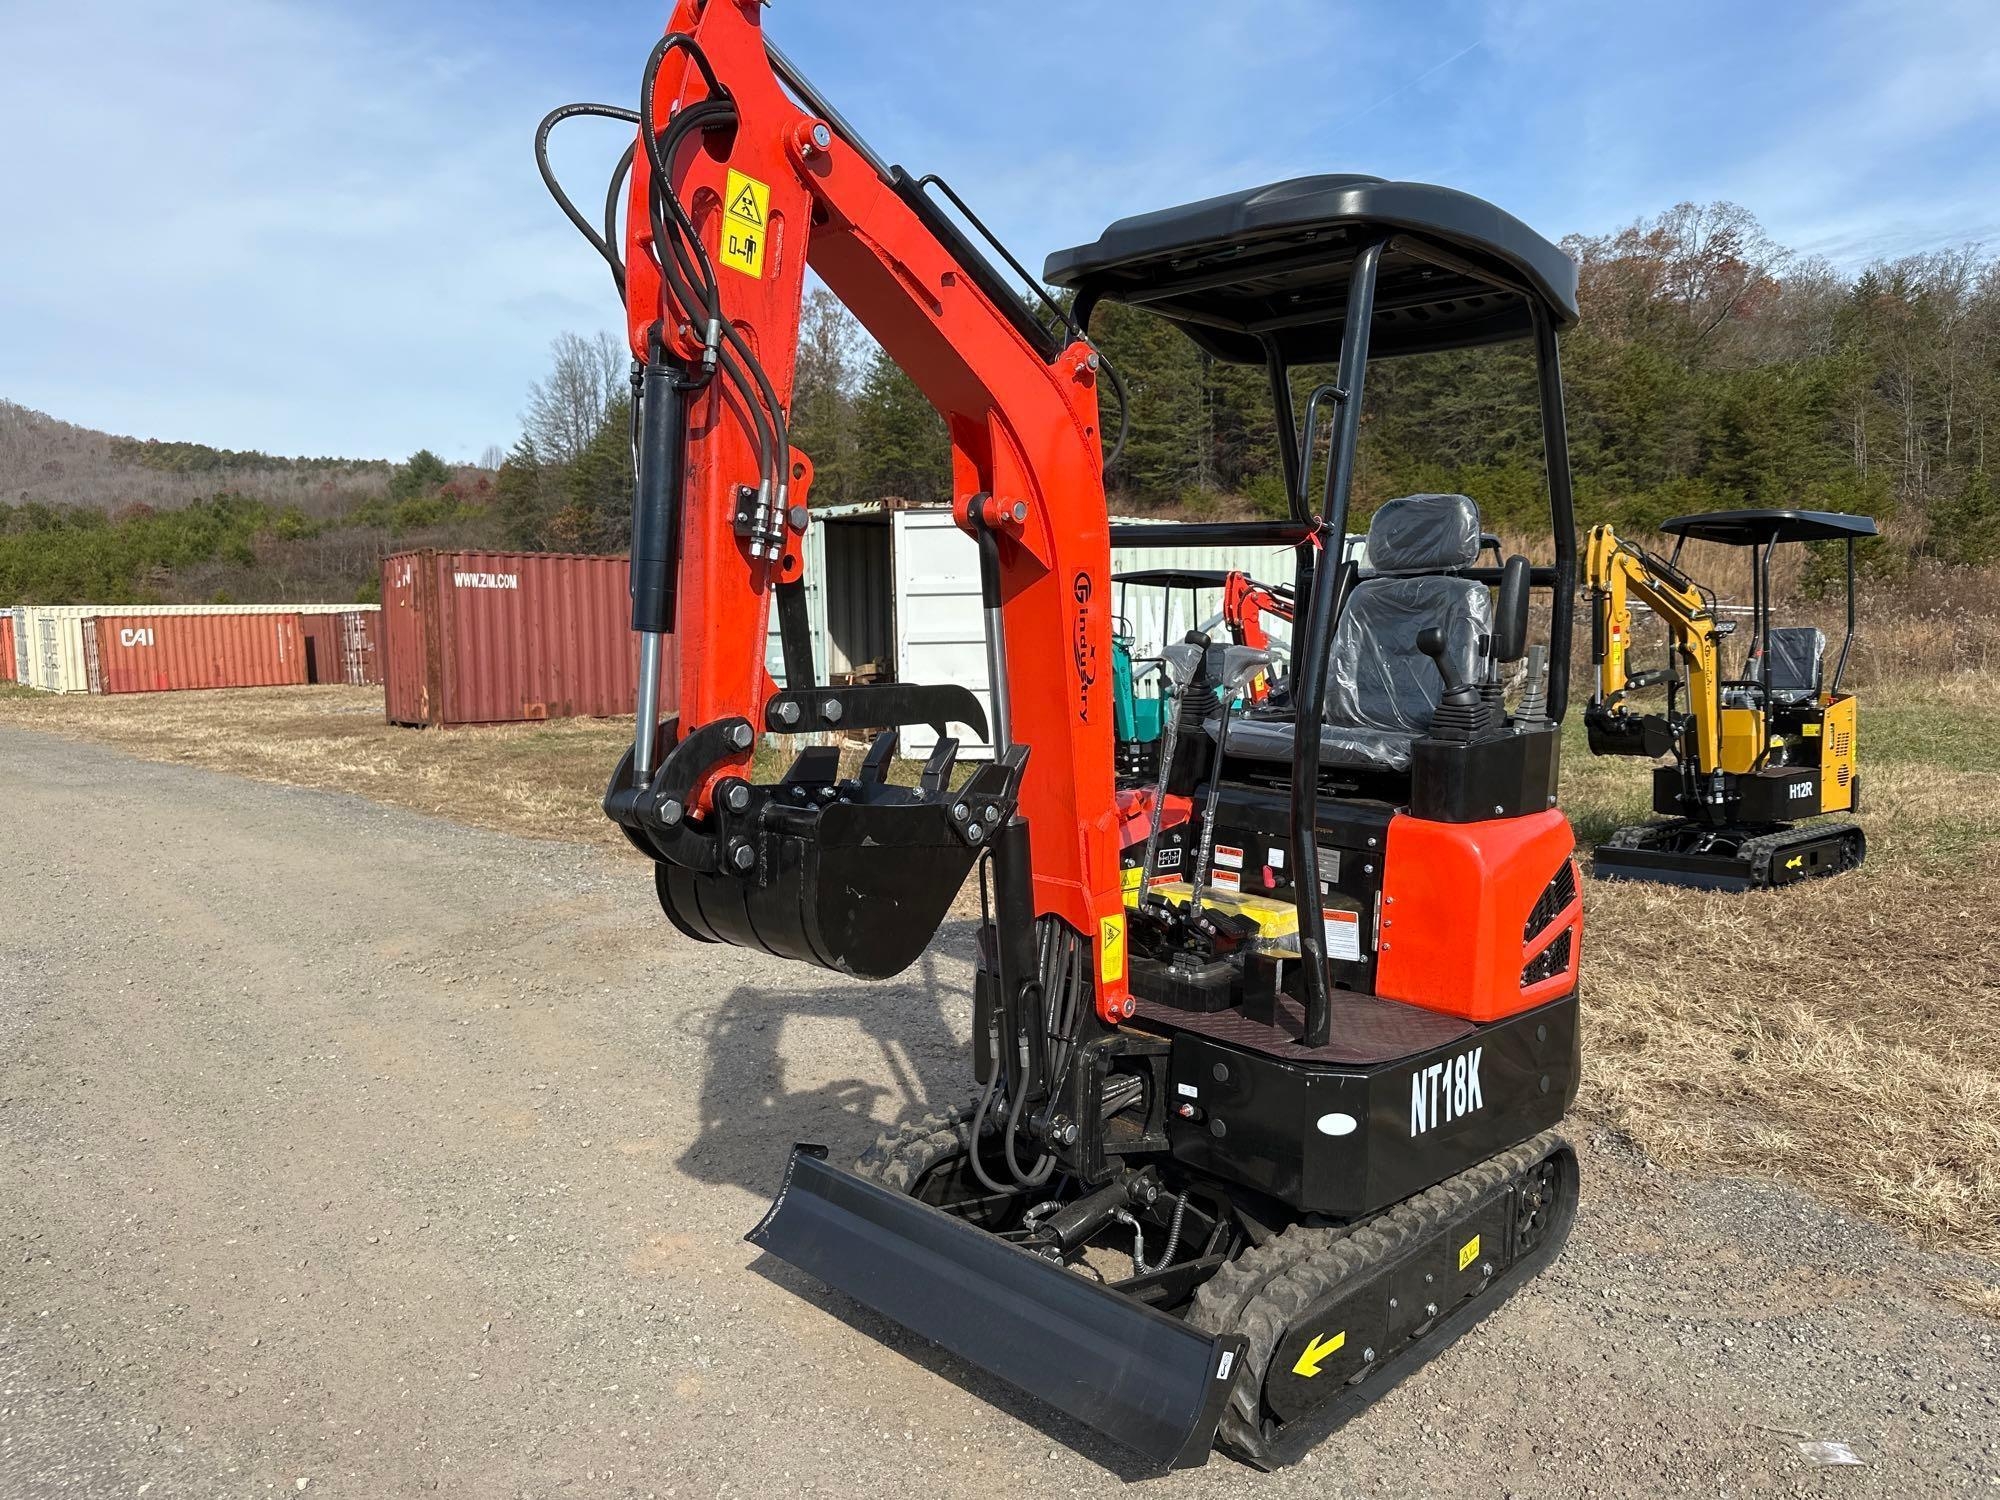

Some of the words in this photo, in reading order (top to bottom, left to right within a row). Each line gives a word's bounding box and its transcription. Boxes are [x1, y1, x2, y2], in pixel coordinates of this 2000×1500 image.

[454, 572, 517, 589] WWW.ZIM.COM
[120, 628, 154, 646] CAI
[1789, 781, 1813, 799] H12R
[1410, 1046, 1483, 1138] NT18K
